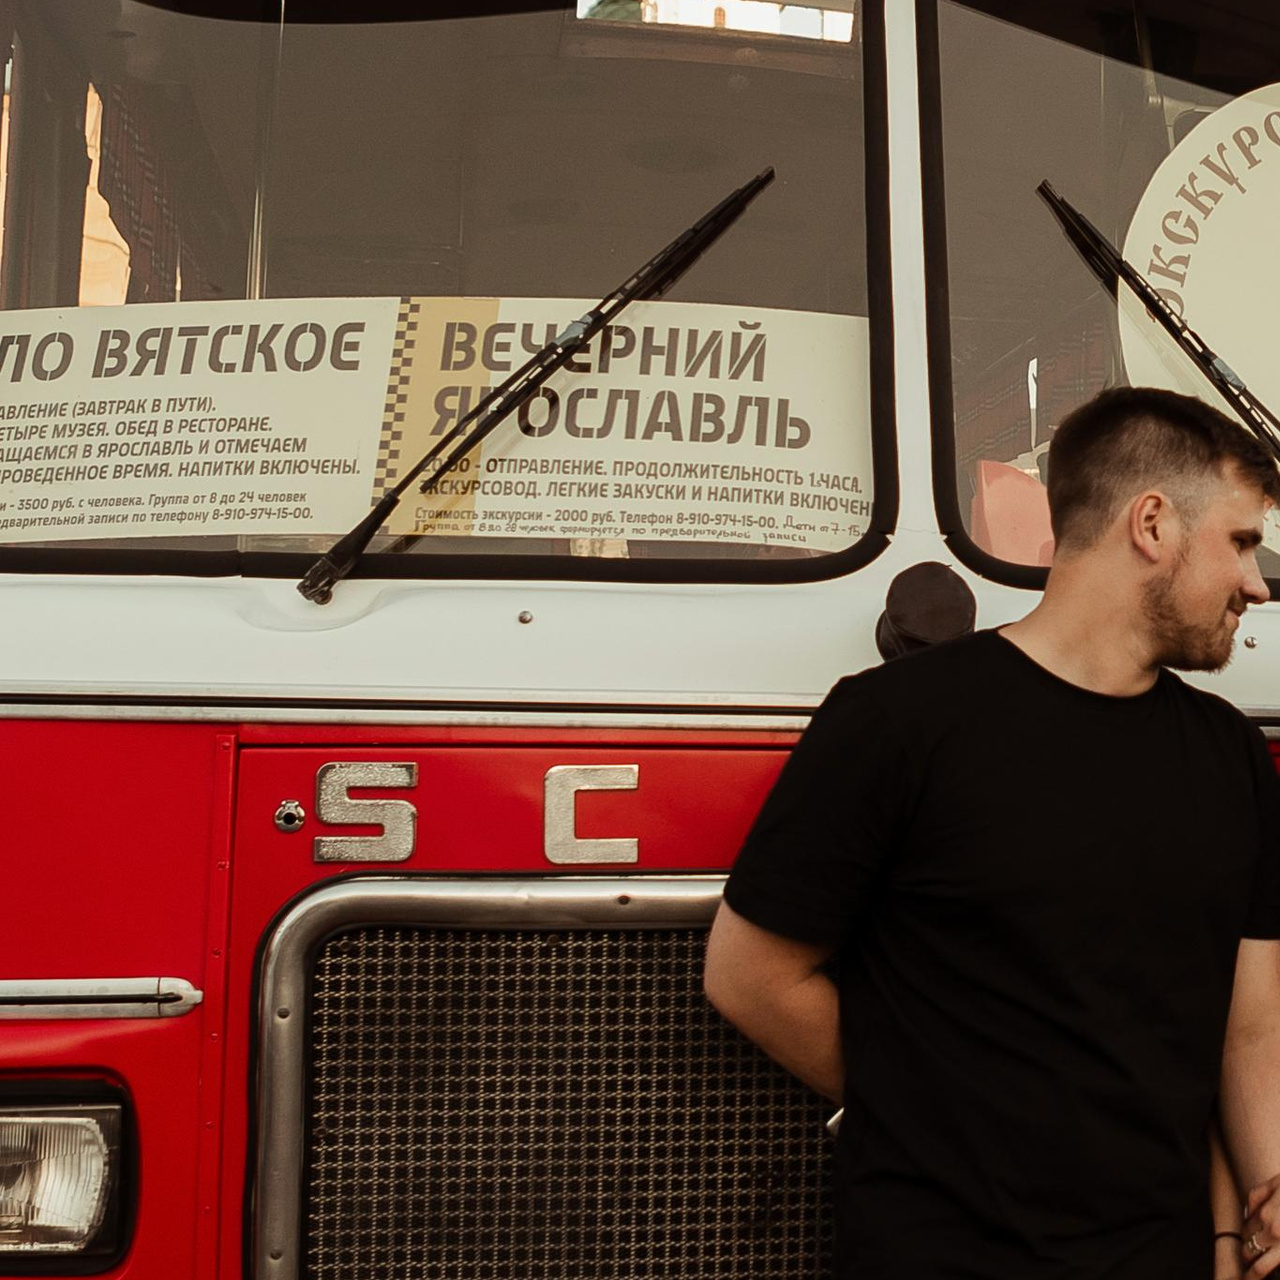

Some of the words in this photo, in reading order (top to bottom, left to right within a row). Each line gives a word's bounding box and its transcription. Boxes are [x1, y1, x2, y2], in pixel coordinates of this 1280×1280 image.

[91, 321, 366, 379] ВЯТСКОЕ
[439, 320, 767, 383] ВЕЧЕРНИЙ
[72, 398, 148, 418] (ЗАВТРАК
[151, 398, 162, 413] В
[166, 396, 216, 414] ПУТИ).
[429, 385, 811, 450] ЯОСЛАВЛЬ
[51, 421, 109, 439] МУЗЕЯ.
[115, 419, 158, 437] ОБЕД
[163, 419, 173, 434] В
[178, 416, 272, 434] РЕСТОРАНЕ.
[82, 444, 92, 459] В
[97, 440, 193, 458] ЯРОСЛАВЛЬ
[198, 439, 210, 454] И
[214, 437, 308, 455] ОТМЕЧАЕМ
[0, 465, 109, 485] РОВЕДЕННОЕ
[112, 462, 173, 480] ВРЕМЯ.
[178, 460, 254, 477] НАПИТКИ
[259, 458, 361, 476] ВКЛЮЧЕНЫ.
[486, 458, 607, 476] ОТПРАВЛЕНИЕ.
[612, 460, 804, 486] ПРОДОЛЖИТЕЛЬНОСТЬ
[17, 498, 49, 511] 3500
[51, 497, 75, 512] руб.
[78, 498, 84, 508] с
[87, 495, 144, 508] человека.
[148, 494, 189, 509] Группа
[193, 494, 206, 504] от
[209, 492, 217, 504] 8
[219, 492, 235, 505] до
[239, 491, 254, 503] 24
[257, 492, 307, 503] человек
[546, 481, 609, 498] ЛЕГКИЕ
[613, 483, 686, 500] ЗАКУСКИ
[691, 485, 702, 501] И
[707, 486, 784, 506] НАПИТКИ
[0, 513, 85, 529] дварительной
[88, 513, 128, 525] записи
[132, 513, 146, 523] по
[150, 510, 210, 524] телефону
[212, 507, 313, 521] 8-910-974-15-00.
[415, 507, 478, 521] Стоимость
[482, 509, 543, 524] экскурсии
[554, 509, 588, 522] 2000
[591, 511, 616, 525] руб.
[619, 511, 672, 526] Телефон
[676, 513, 779, 530] 8-910-974-15-00.
[632, 527, 646, 535] по
